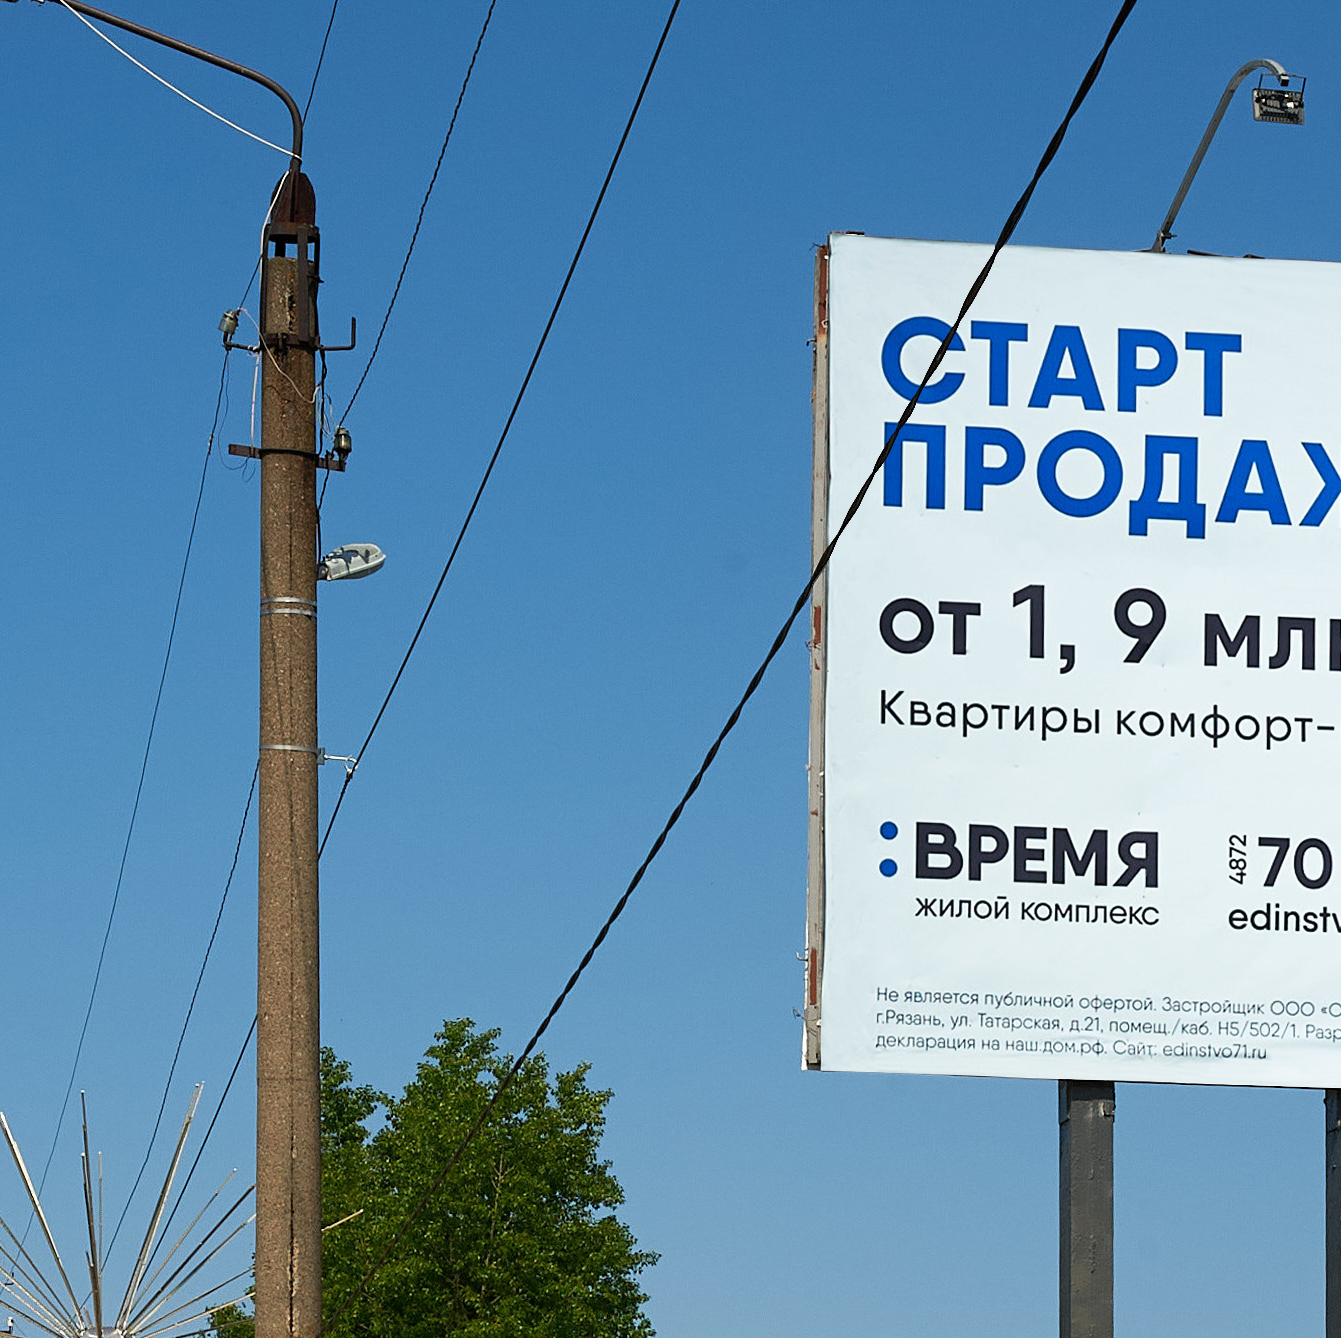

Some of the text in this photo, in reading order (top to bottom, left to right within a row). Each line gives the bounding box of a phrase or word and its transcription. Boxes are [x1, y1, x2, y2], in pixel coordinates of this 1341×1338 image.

[881, 316, 1242, 417] СТАРТ
[879, 598, 981, 655] от
[1114, 588, 1166, 663] 9
[881, 690, 1099, 740] Квартиры
[1229, 835, 1246, 884] 4872
[1258, 837, 1332, 889] 70
[915, 896, 1159, 925] жилой комплекс
[877, 987, 899, 1002] Не
[904, 991, 978, 1004] является
[985, 992, 1073, 1009] публичной
[1079, 995, 1156, 1013] офертой.
[1162, 997, 1264, 1016] Застройщик
[877, 1010, 944, 1027] г.Рязань,
[950, 1016, 971, 1030] ул.
[978, 1013, 1063, 1032] Татарская,
[1069, 1017, 1103, 1033] д.21,
[876, 1035, 975, 1051] декларация
[982, 1039, 1000, 1050] на
[1163, 1043, 1266, 1059] edinstvo71.ru
